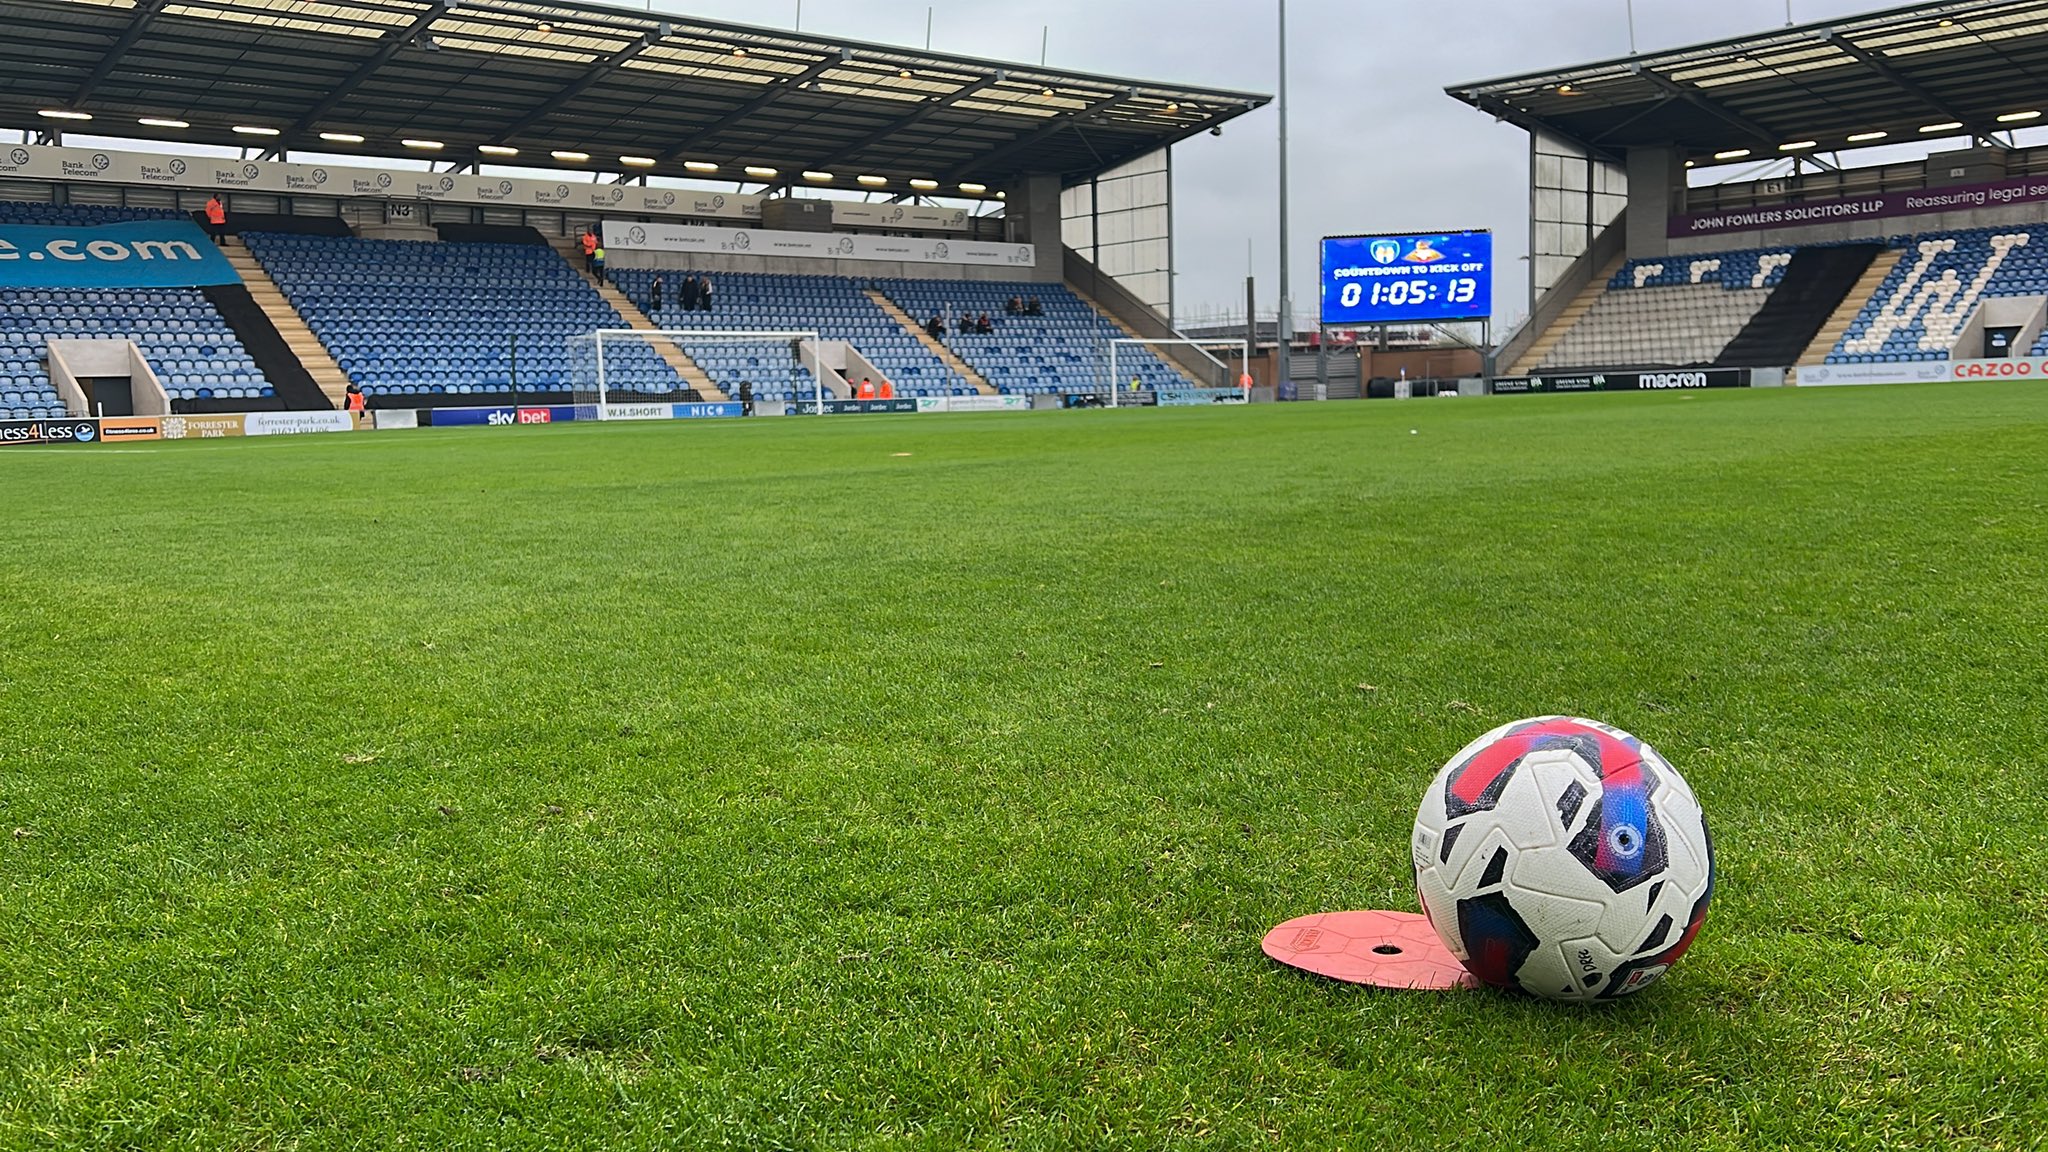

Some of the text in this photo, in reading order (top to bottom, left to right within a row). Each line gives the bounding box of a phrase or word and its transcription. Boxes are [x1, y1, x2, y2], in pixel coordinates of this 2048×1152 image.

[61, 160, 84, 169] Bank
[141, 165, 162, 173] Bank
[62, 168, 98, 176] Telecom
[141, 173, 176, 181] Telecom
[216, 170, 235, 178] Bank
[216, 177, 248, 186] Telecom
[287, 182, 318, 190] Telecom
[353, 179, 370, 187] Bank
[1907, 184, 2048, 208] Reassuring legal se
[391, 204, 410, 216] N3
[1691, 201, 1884, 230] JOHN FOWLERS SOLICITORS LLP
[1333, 262, 1484, 279] COUNTDOWN TO KICK OFF
[1954, 362, 2032, 377] CAZOO
[1638, 372, 1707, 388] macron
[607, 407, 663, 417] W.H.SHORT
[802, 403, 834, 414] Jorec
[257, 415, 341, 427] forrester-park.co.uk
[487, 410, 549, 426] sky bet
[188, 420, 239, 430] FORRESTER
[0, 423, 73, 440] ess4Less
[201, 429, 225, 438] PARK
[1577, 948, 1597, 972] DRFC
